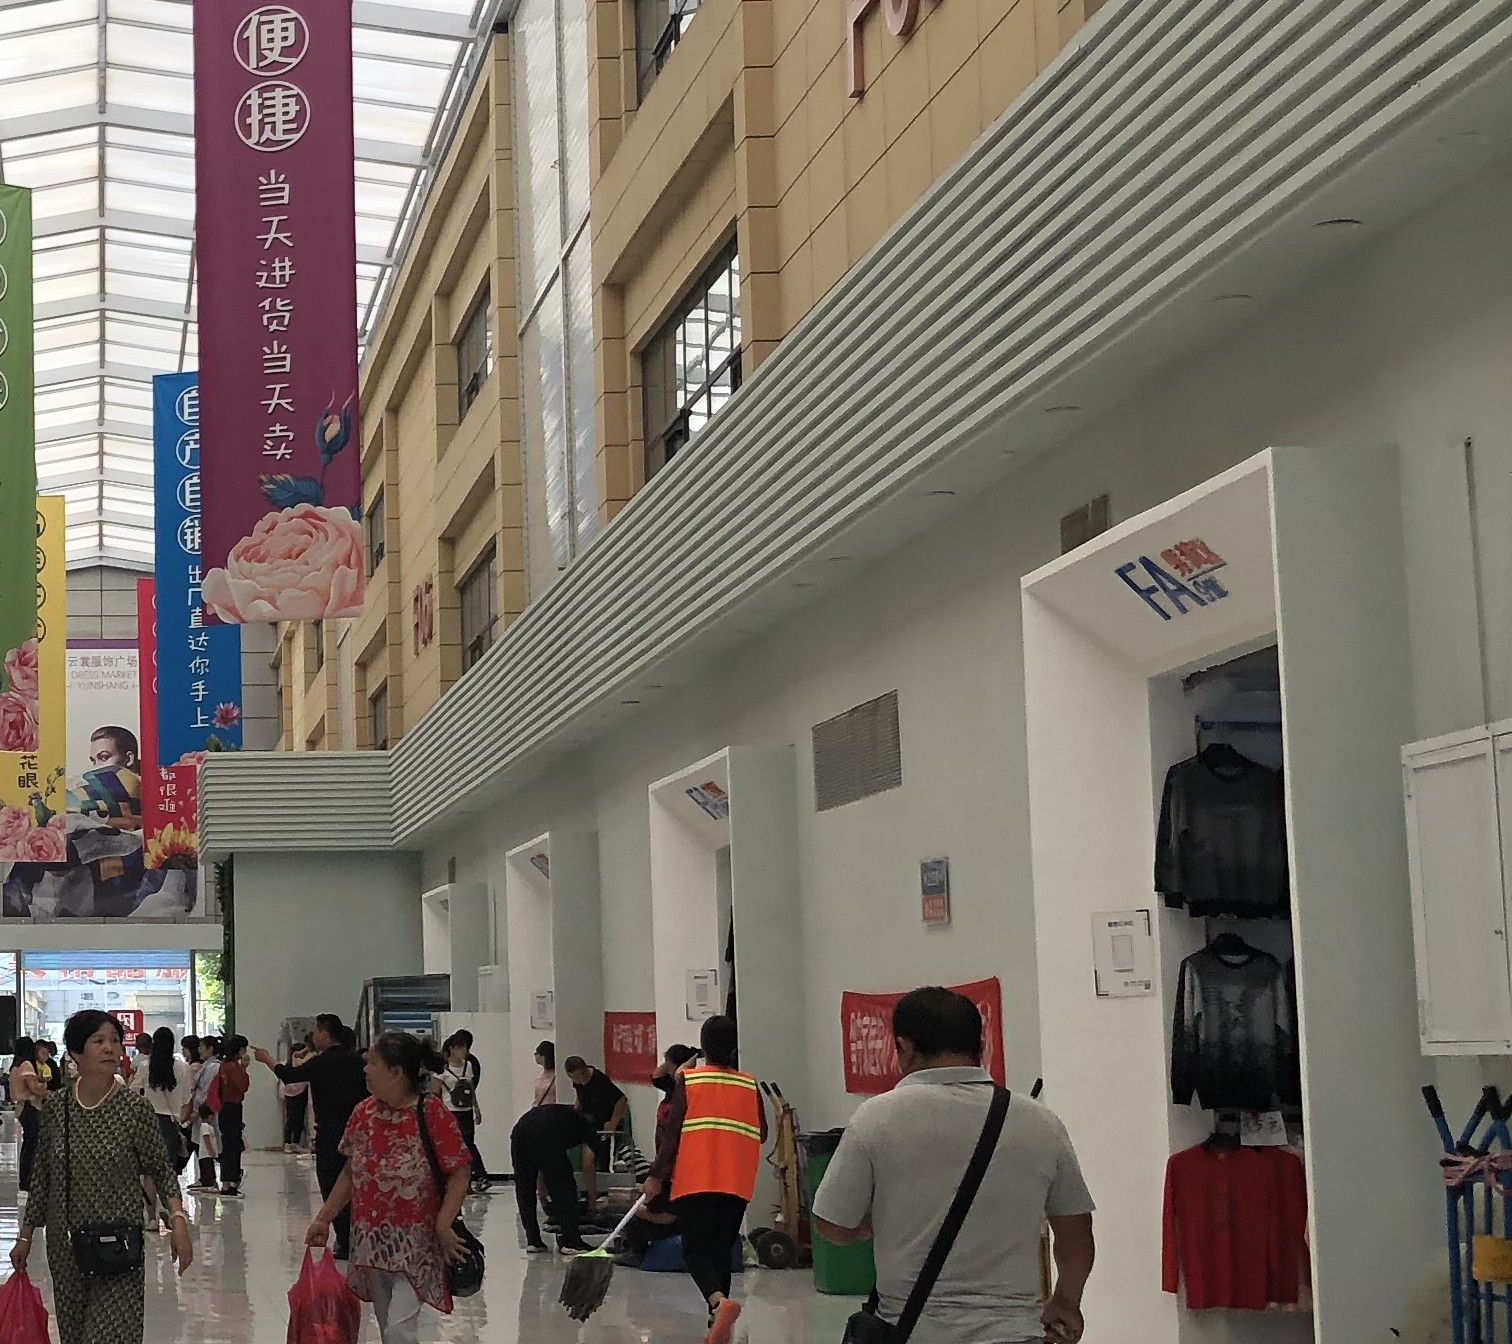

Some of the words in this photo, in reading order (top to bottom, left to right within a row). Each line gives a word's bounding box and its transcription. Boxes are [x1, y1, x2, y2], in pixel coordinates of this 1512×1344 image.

[254, 168, 296, 462] 当天进货当天卖
[1114, 555, 1208, 620] FA
[71, 670, 99, 680] DRESS
[101, 670, 138, 680] MARKET
